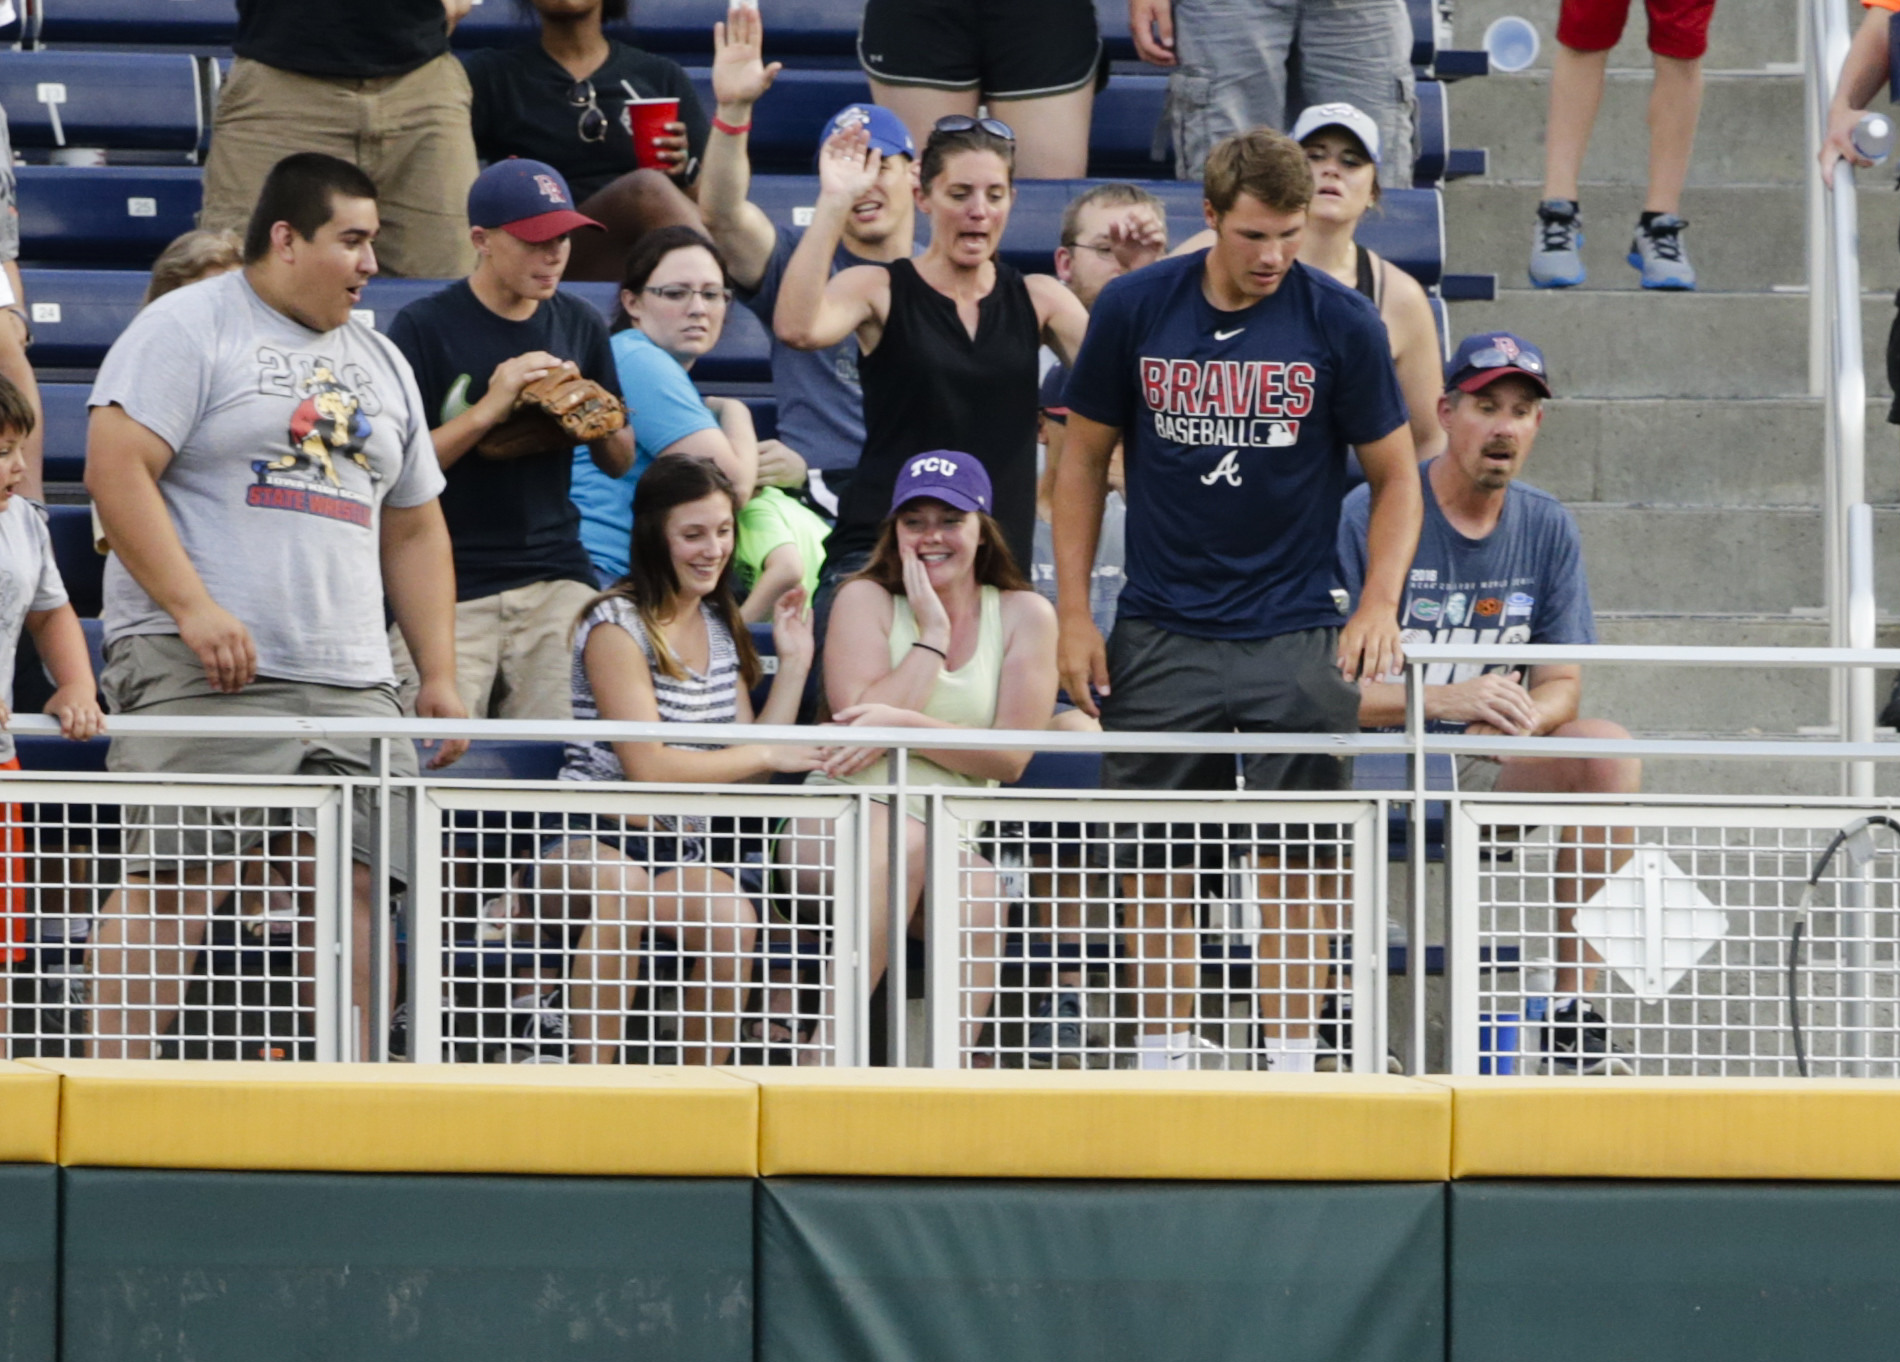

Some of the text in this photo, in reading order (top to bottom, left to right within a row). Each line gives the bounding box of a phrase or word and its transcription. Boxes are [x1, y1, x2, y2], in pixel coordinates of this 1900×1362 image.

[1140, 356, 1316, 417] BRAVES
[1154, 413, 1250, 447] BASEBALL
[911, 456, 958, 478] TCU
[247, 484, 305, 511] STATE
